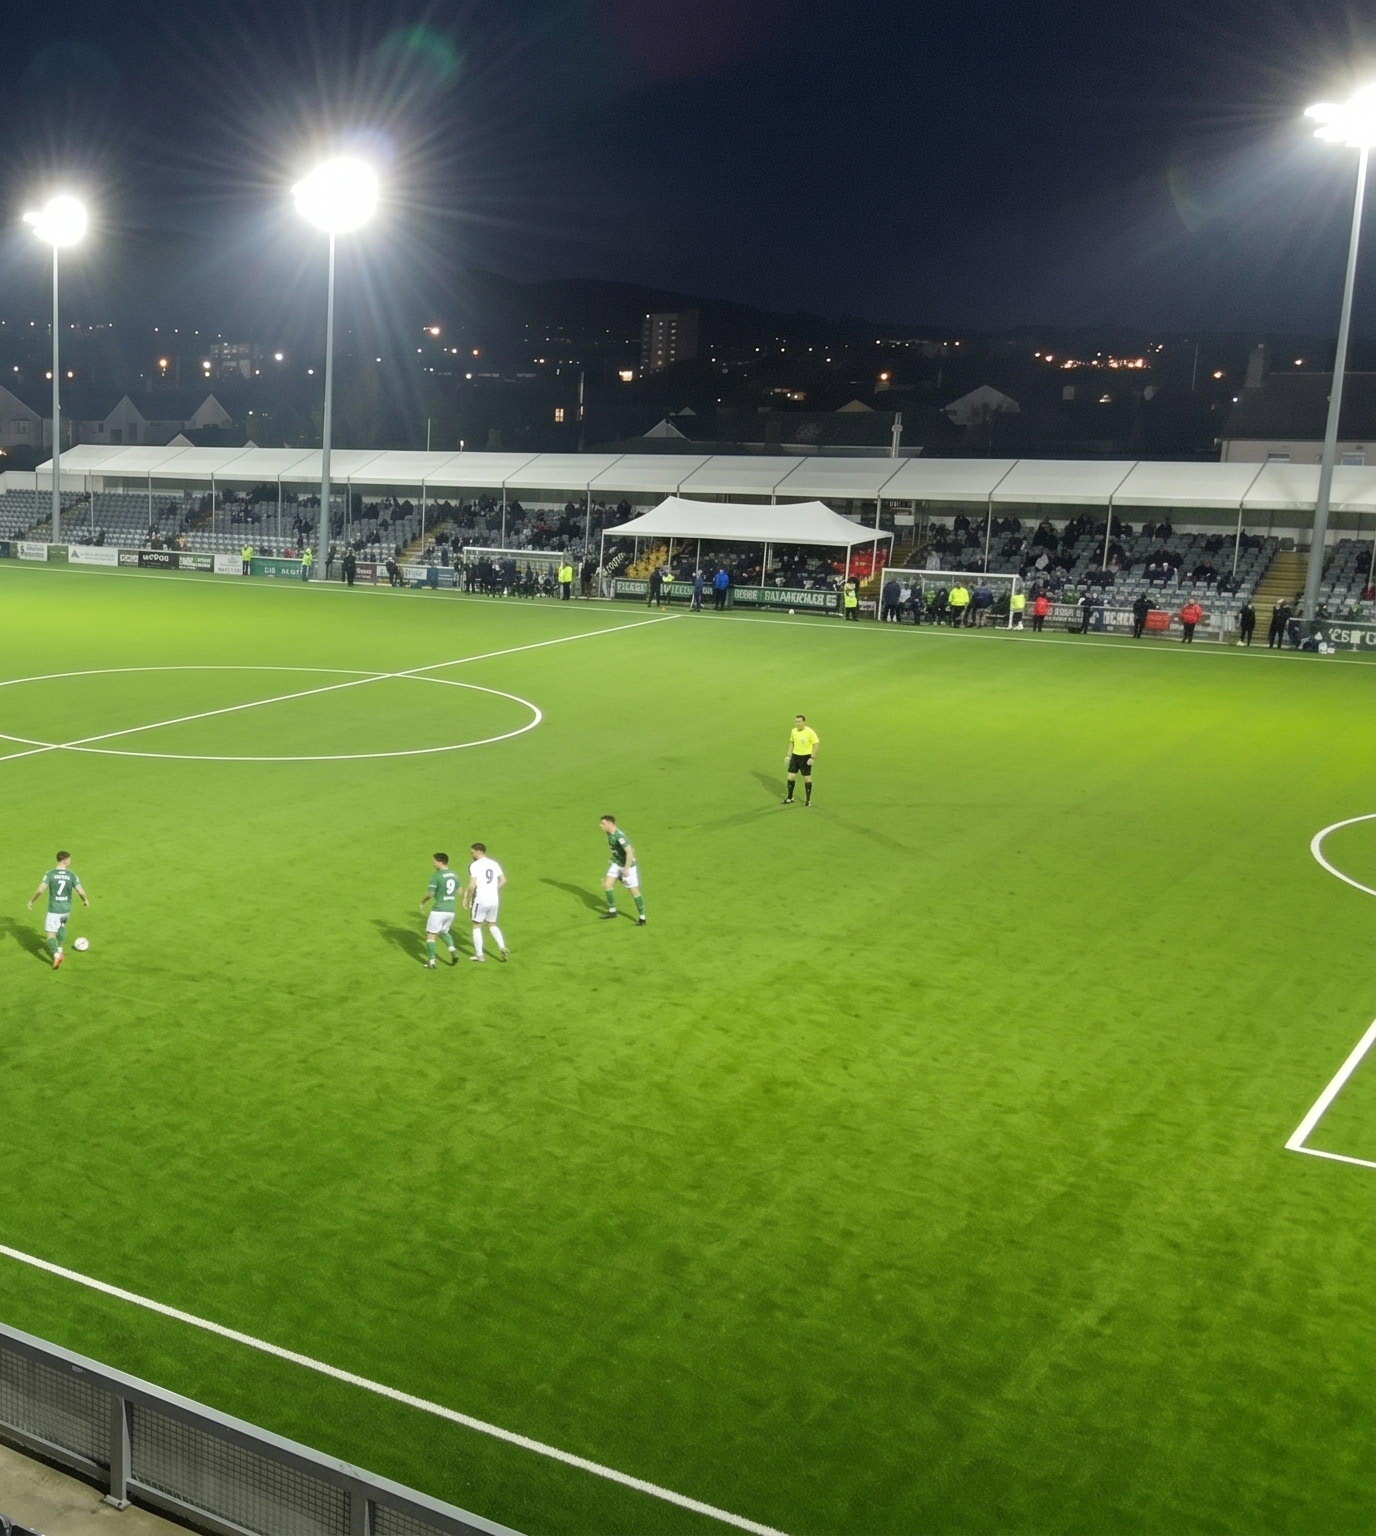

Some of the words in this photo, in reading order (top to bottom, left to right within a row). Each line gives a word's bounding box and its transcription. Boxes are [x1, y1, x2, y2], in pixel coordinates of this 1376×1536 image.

[485, 869, 494, 885] 9
[56, 880, 66, 896] 7
[446, 879, 456, 895] 9
